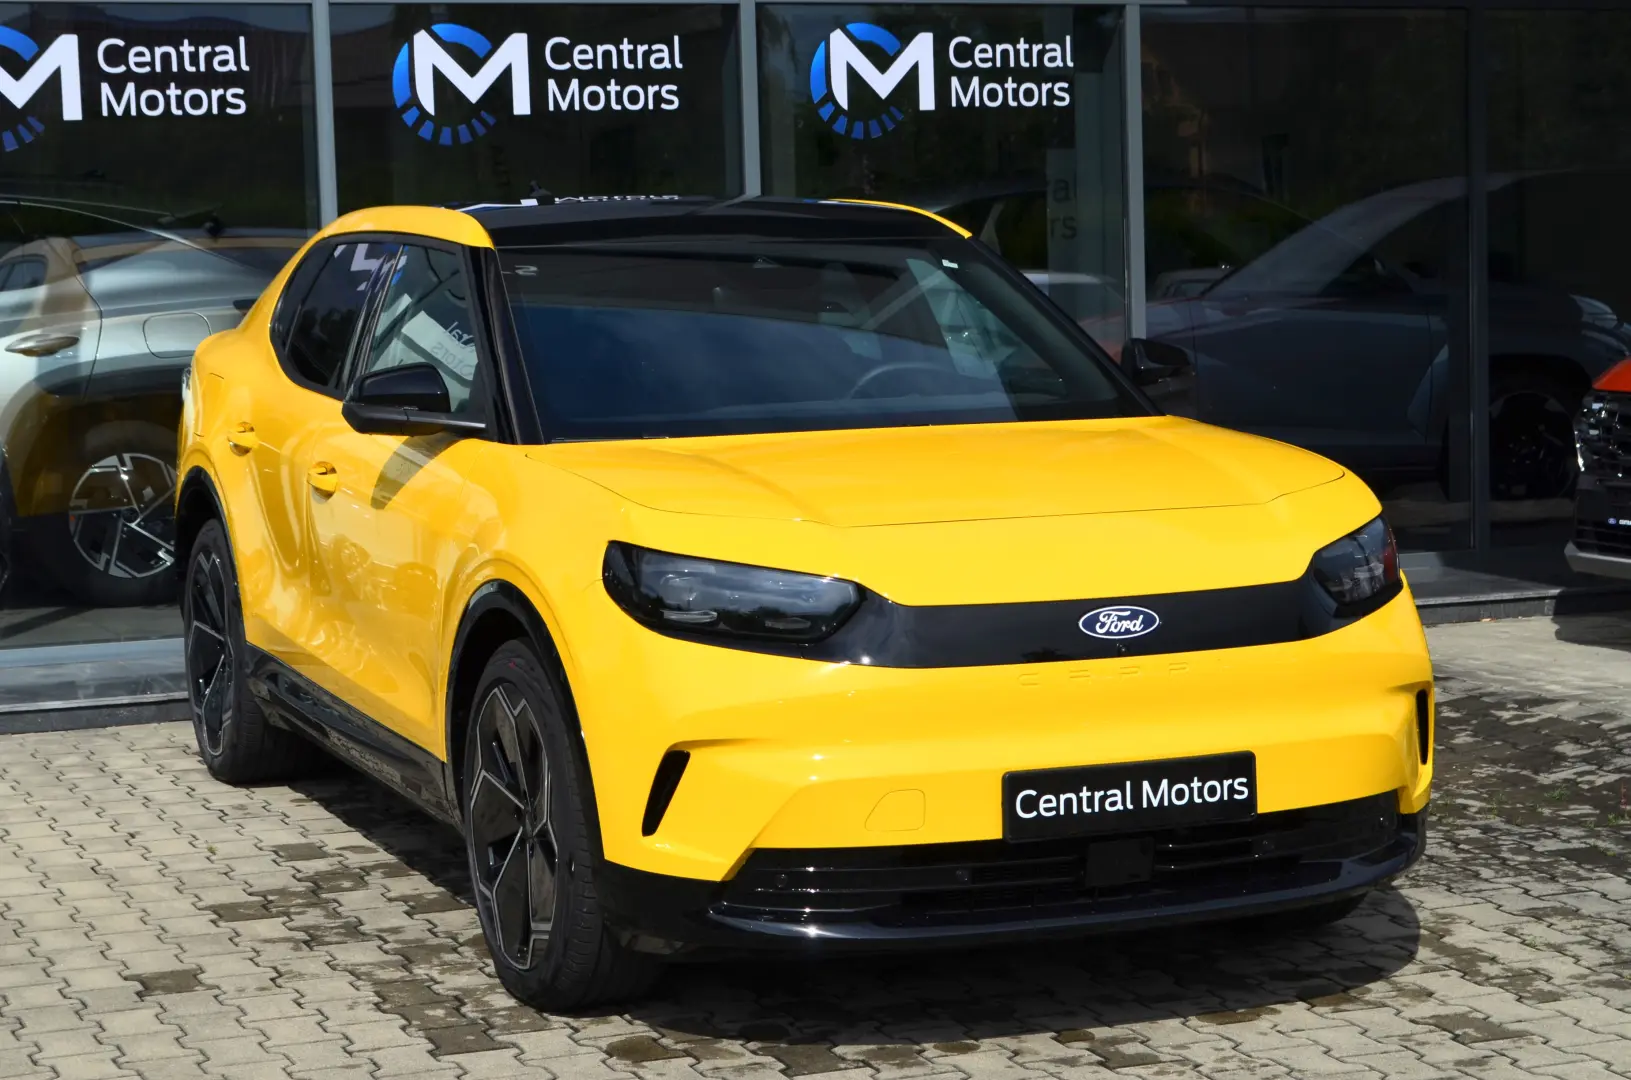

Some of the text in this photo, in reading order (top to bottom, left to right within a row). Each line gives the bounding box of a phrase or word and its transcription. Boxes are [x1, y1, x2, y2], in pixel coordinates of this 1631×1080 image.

[97, 35, 250, 74] Central
[544, 34, 683, 71] Central
[948, 34, 1074, 69] Central
[100, 81, 247, 117] Motors
[547, 78, 680, 112] Motors
[950, 75, 1071, 108] Motors
[1095, 610, 1144, 634] Ford
[1015, 776, 1249, 819] Central Motors
